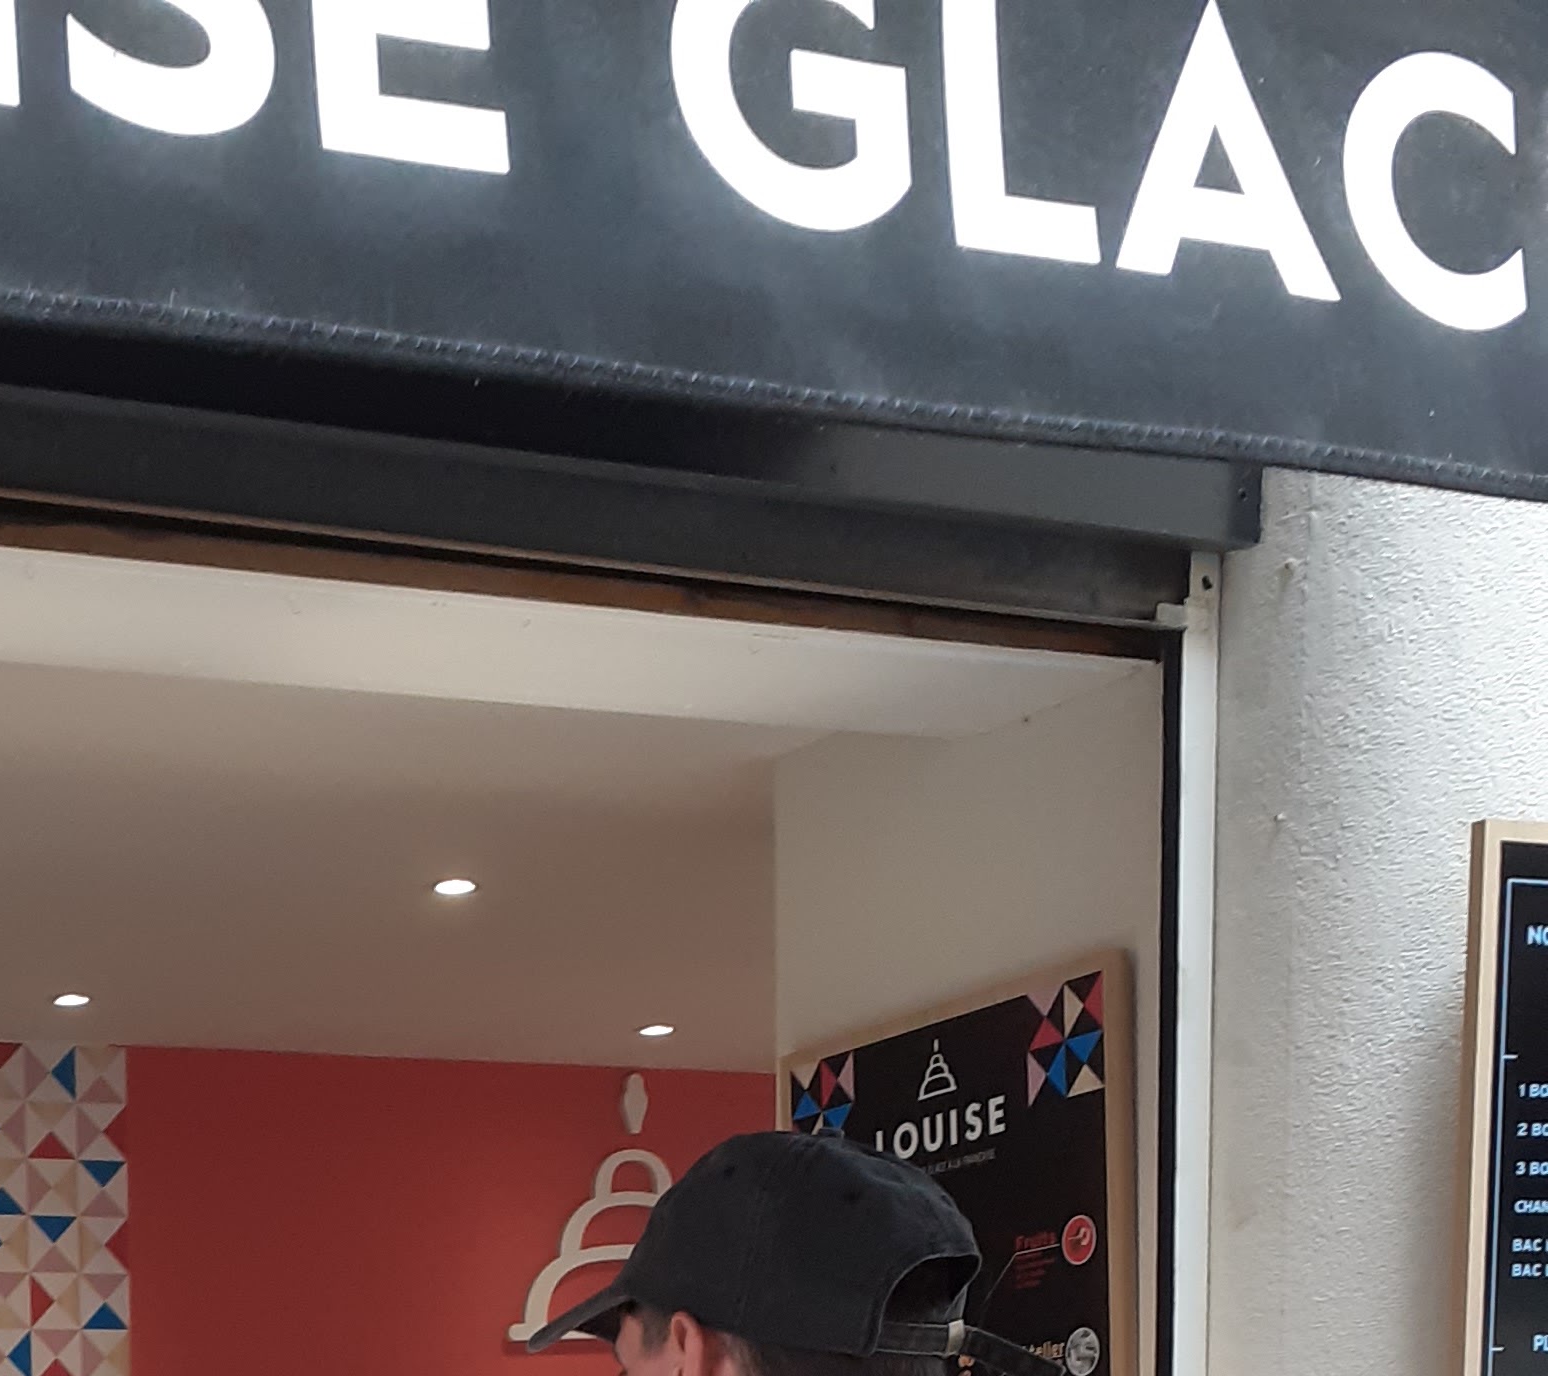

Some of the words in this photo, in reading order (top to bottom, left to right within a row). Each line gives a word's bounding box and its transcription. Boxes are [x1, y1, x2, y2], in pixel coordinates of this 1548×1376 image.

[1519, 1083, 1526, 1098] 1
[1517, 1122, 1528, 1137] 2
[1515, 1161, 1526, 1176] 3
[1512, 1238, 1542, 1253] BAC
[1511, 1264, 1542, 1278] BAC
